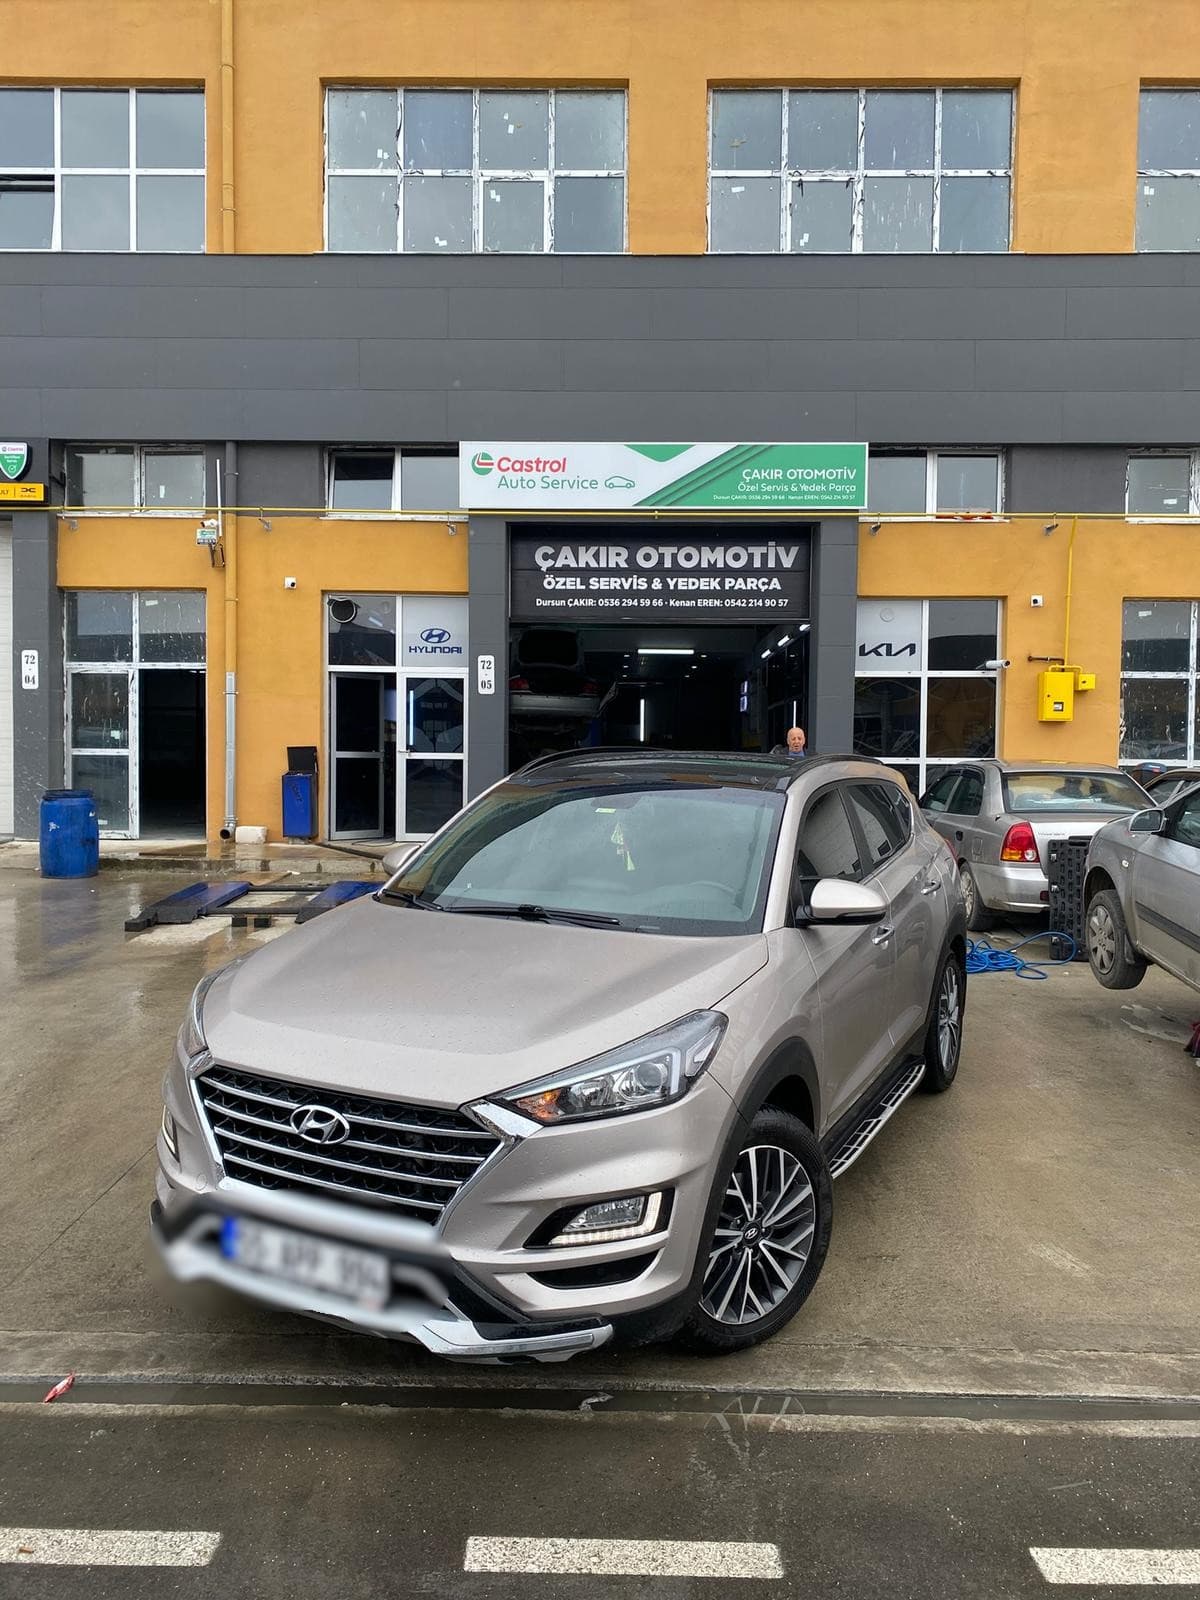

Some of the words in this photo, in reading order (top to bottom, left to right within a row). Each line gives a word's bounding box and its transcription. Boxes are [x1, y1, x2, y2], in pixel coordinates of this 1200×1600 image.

[497, 457, 567, 473] Castrol
[742, 468, 783, 482] ÇAKIR
[787, 466, 857, 480] OTOMOTİV
[497, 476, 536, 489] Auto
[540, 475, 598, 489] Service
[737, 482, 759, 492] Özel
[760, 482, 789, 492] Servis
[791, 483, 798, 492] &
[799, 483, 827, 492] Yedek
[829, 483, 856, 493] Parça
[534, 545, 629, 572] ÇAKIR
[636, 541, 800, 569] OTOMOTİV
[543, 574, 586, 590] ÖZEL
[589, 574, 648, 590] SERVİS
[651, 577, 663, 590] &
[666, 577, 721, 590] YEDEK
[724, 577, 782, 592] PARÇA
[536, 598, 566, 607] Dursun
[567, 598, 597, 608] ÇAKIR:
[598, 598, 620, 607] 0536
[621, 598, 638, 607] 294
[639, 598, 651, 607] 59
[652, 598, 663, 607] 66
[669, 598, 696, 607] Kenan
[697, 598, 723, 607] EREN:
[724, 598, 747, 607] 0542
[748, 598, 763, 607] 214
[764, 598, 776, 607] 90
[778, 598, 789, 607] 57
[408, 646, 463, 654] HYUNDAI
[24, 654, 36, 665] 72
[480, 660, 492, 670] 72
[24, 675, 36, 685] 04
[480, 680, 492, 689] 05
